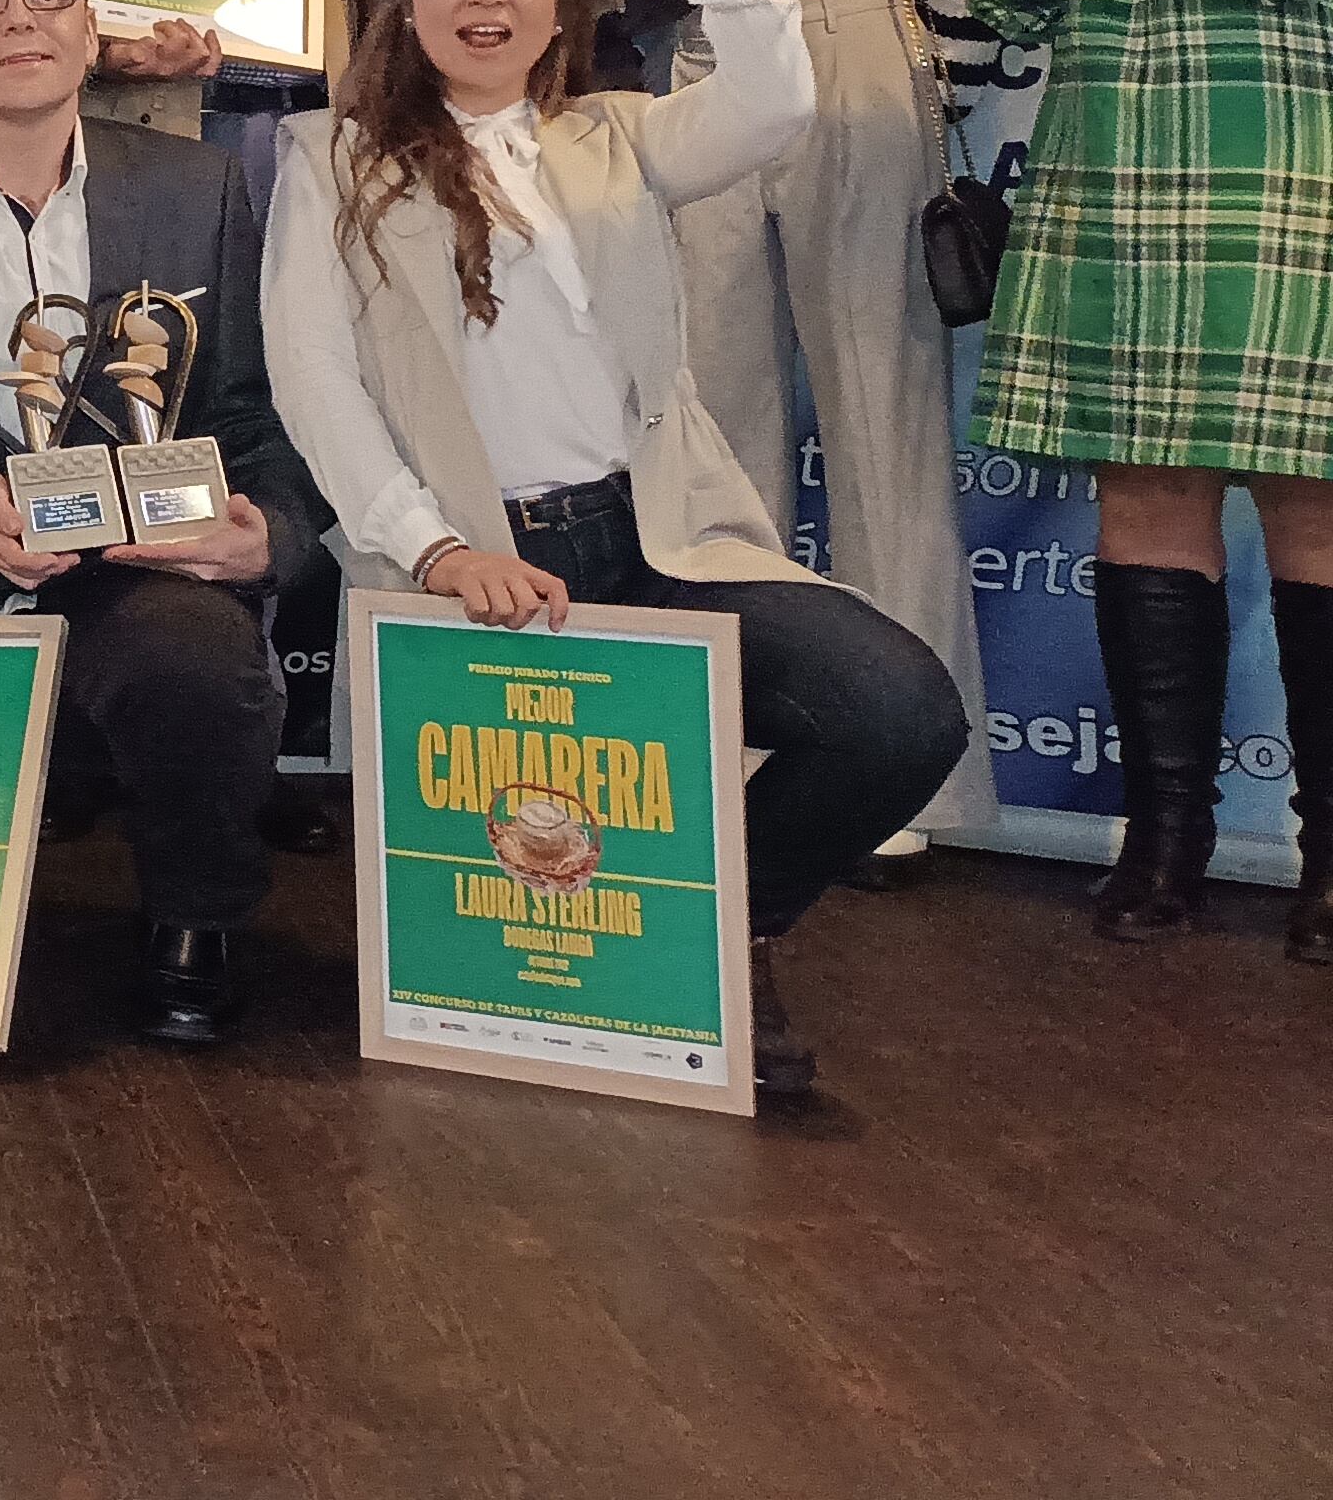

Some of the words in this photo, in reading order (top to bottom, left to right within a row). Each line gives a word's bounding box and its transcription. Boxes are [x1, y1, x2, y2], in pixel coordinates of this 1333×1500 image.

[505, 683, 575, 726] MEJOR
[417, 721, 675, 833] CAMARERA
[455, 872, 528, 922] LAURA
[532, 887, 643, 937] STERLING
